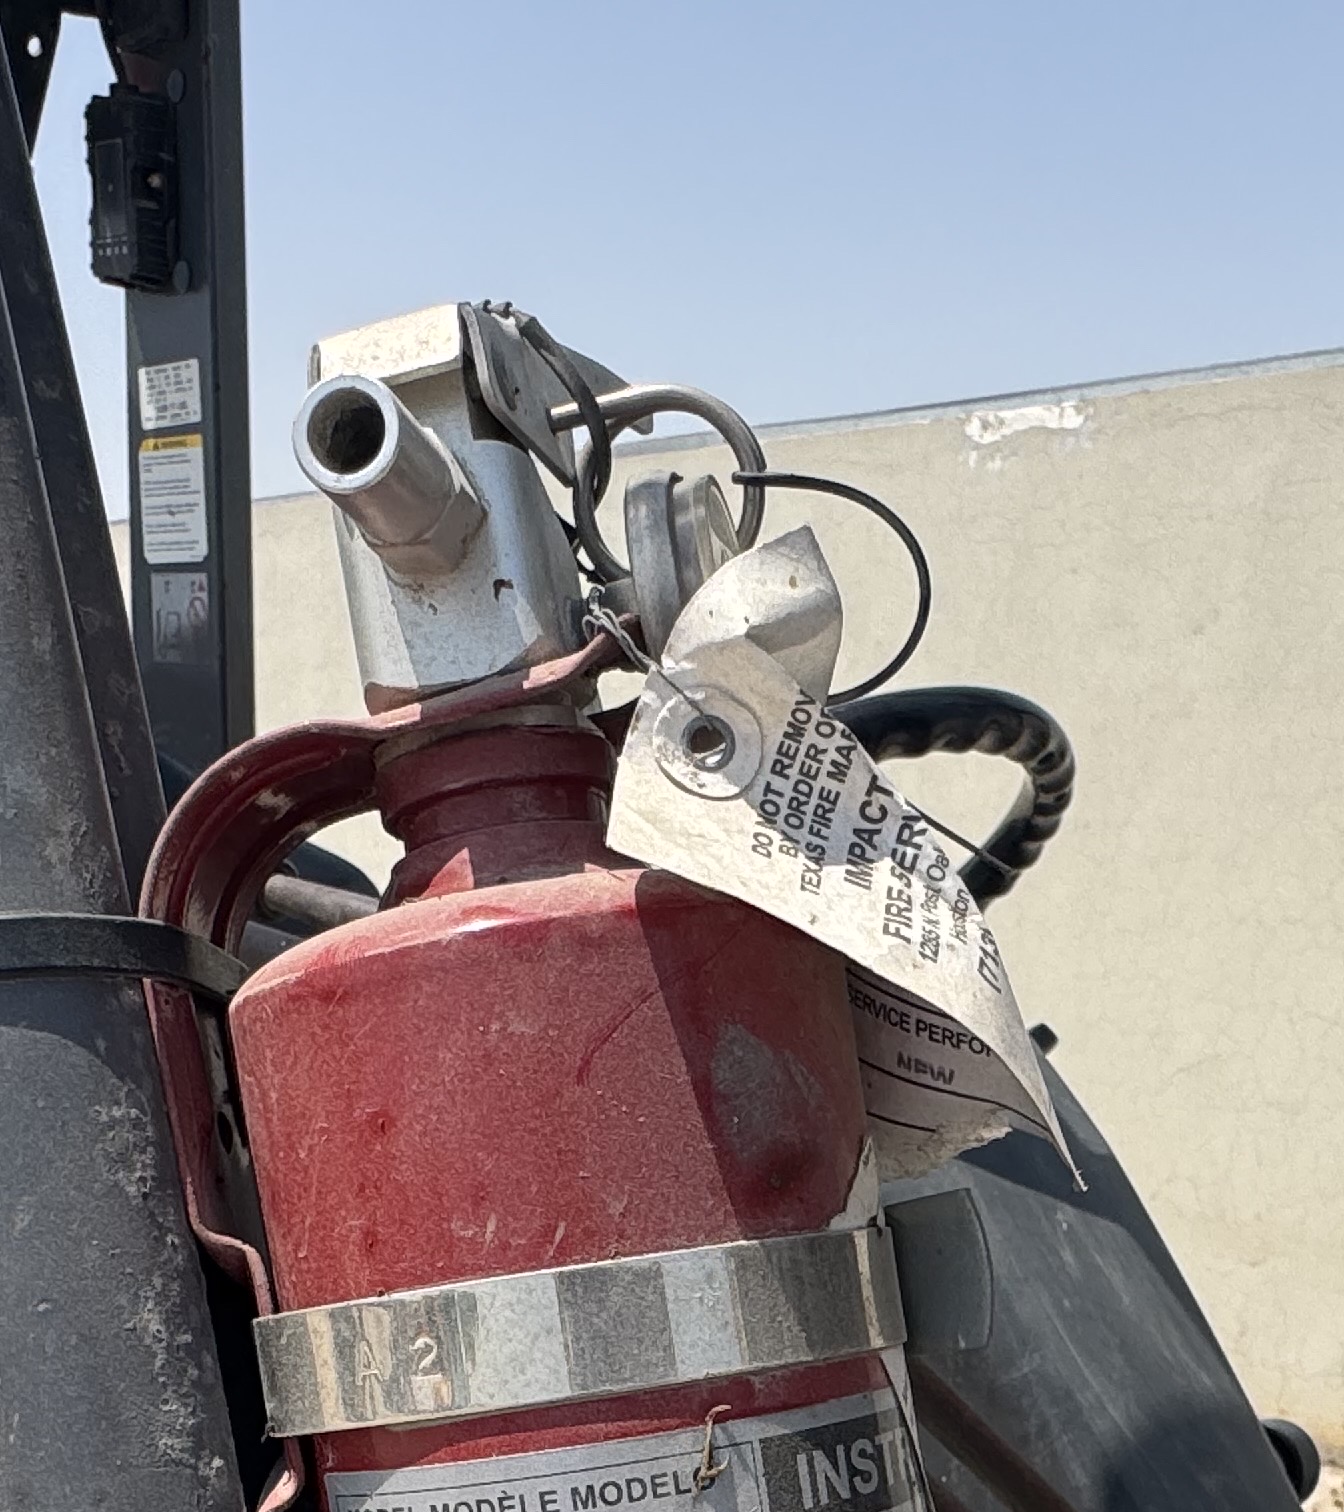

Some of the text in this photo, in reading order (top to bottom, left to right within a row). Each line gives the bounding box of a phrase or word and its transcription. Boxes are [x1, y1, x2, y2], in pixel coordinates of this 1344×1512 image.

[751, 690, 816, 859] DO NOT REMOV
[783, 743, 829, 831] ORDER
[807, 786, 842, 842] FIRE
[843, 773, 895, 891] IMPACT
[778, 829, 801, 858] BY
[800, 842, 827, 895] TEXAS
[882, 886, 914, 945] FIRE
[896, 1050, 956, 1086] NEW
